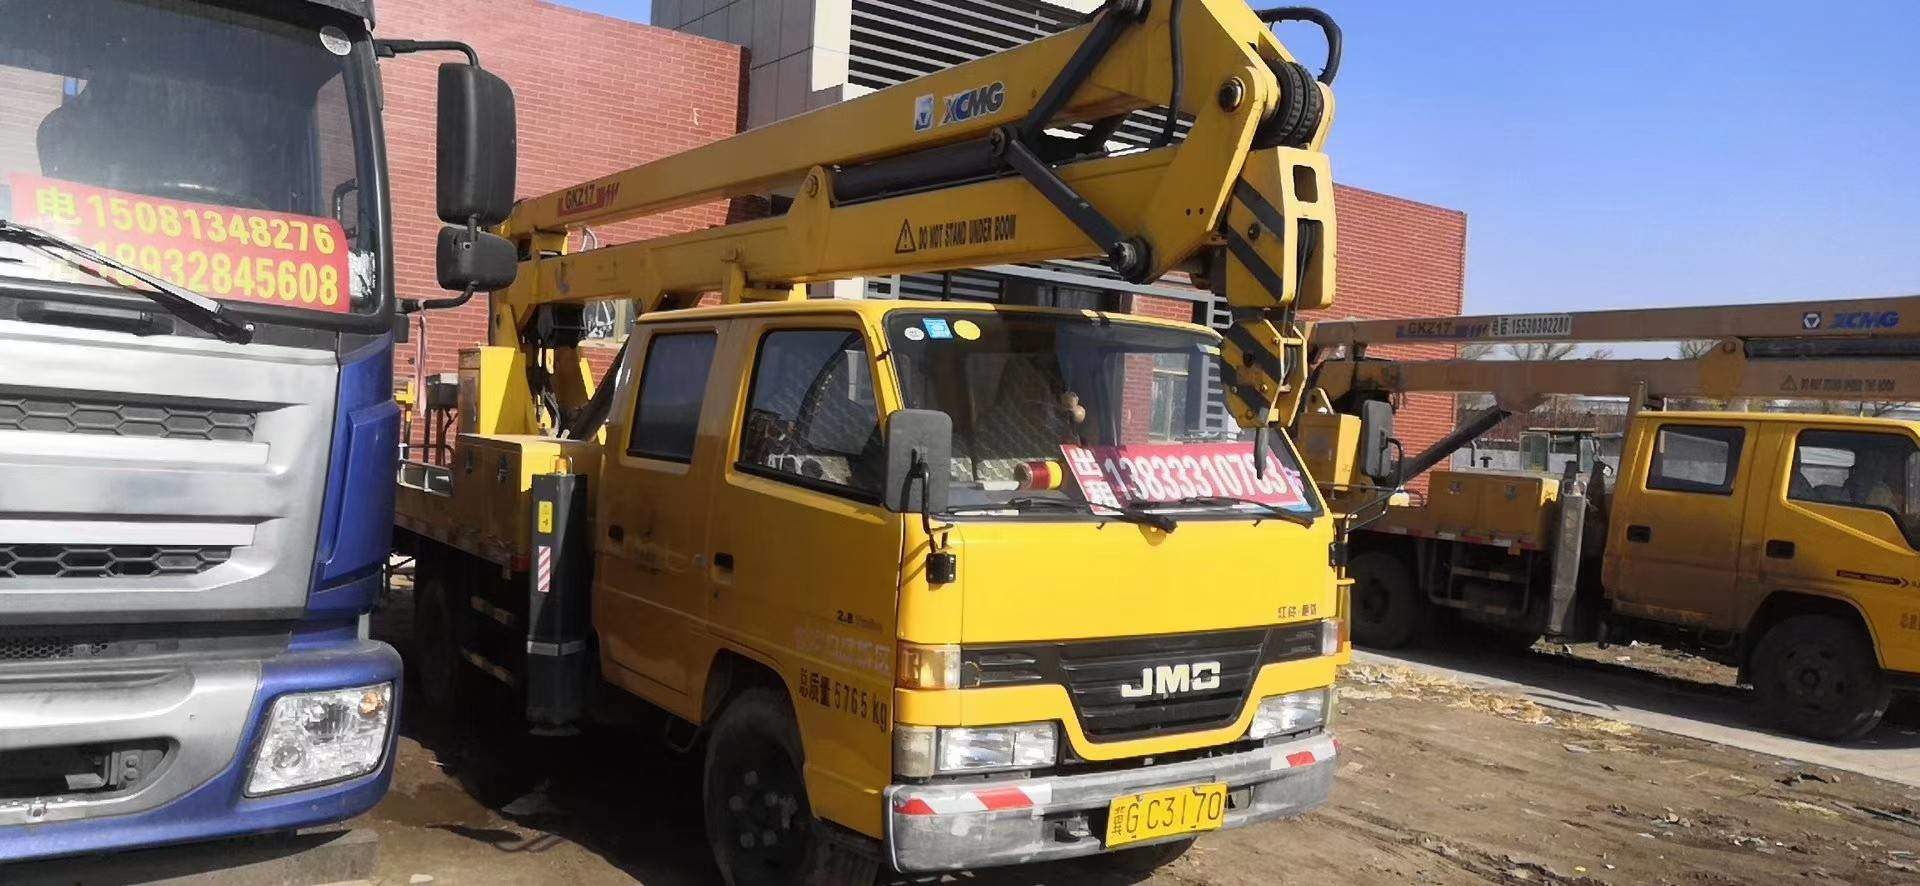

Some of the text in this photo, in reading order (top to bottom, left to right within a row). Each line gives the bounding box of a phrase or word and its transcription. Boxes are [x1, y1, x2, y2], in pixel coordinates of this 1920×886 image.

[942, 82, 1005, 125] XCMG
[87, 195, 335, 254] 15081348276
[1121, 661, 1221, 697] JMC
[833, 681, 868, 719] 5765
